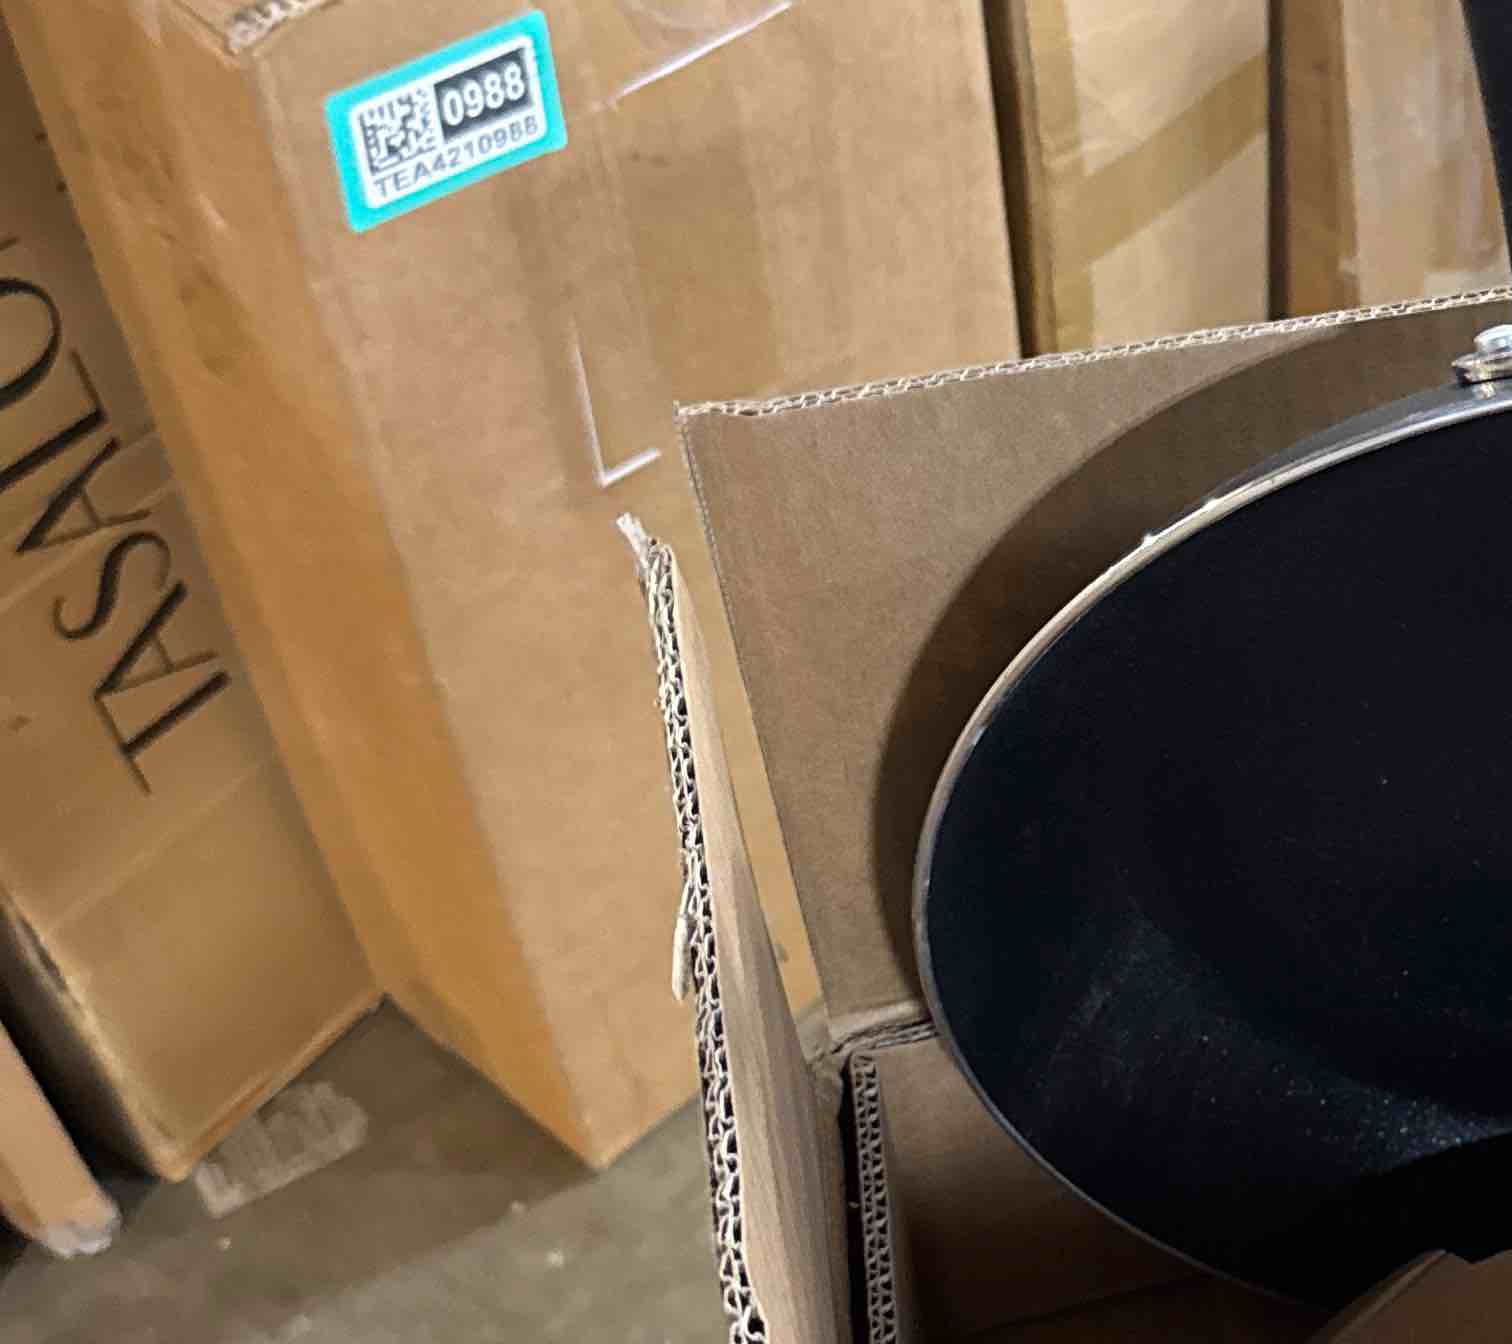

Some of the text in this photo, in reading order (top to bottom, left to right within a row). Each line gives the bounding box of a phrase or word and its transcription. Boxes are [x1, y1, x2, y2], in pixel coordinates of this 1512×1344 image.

[442, 61, 526, 127] 0988
[372, 114, 540, 198] TEA4210988
[0, 236, 232, 796] TASALO
